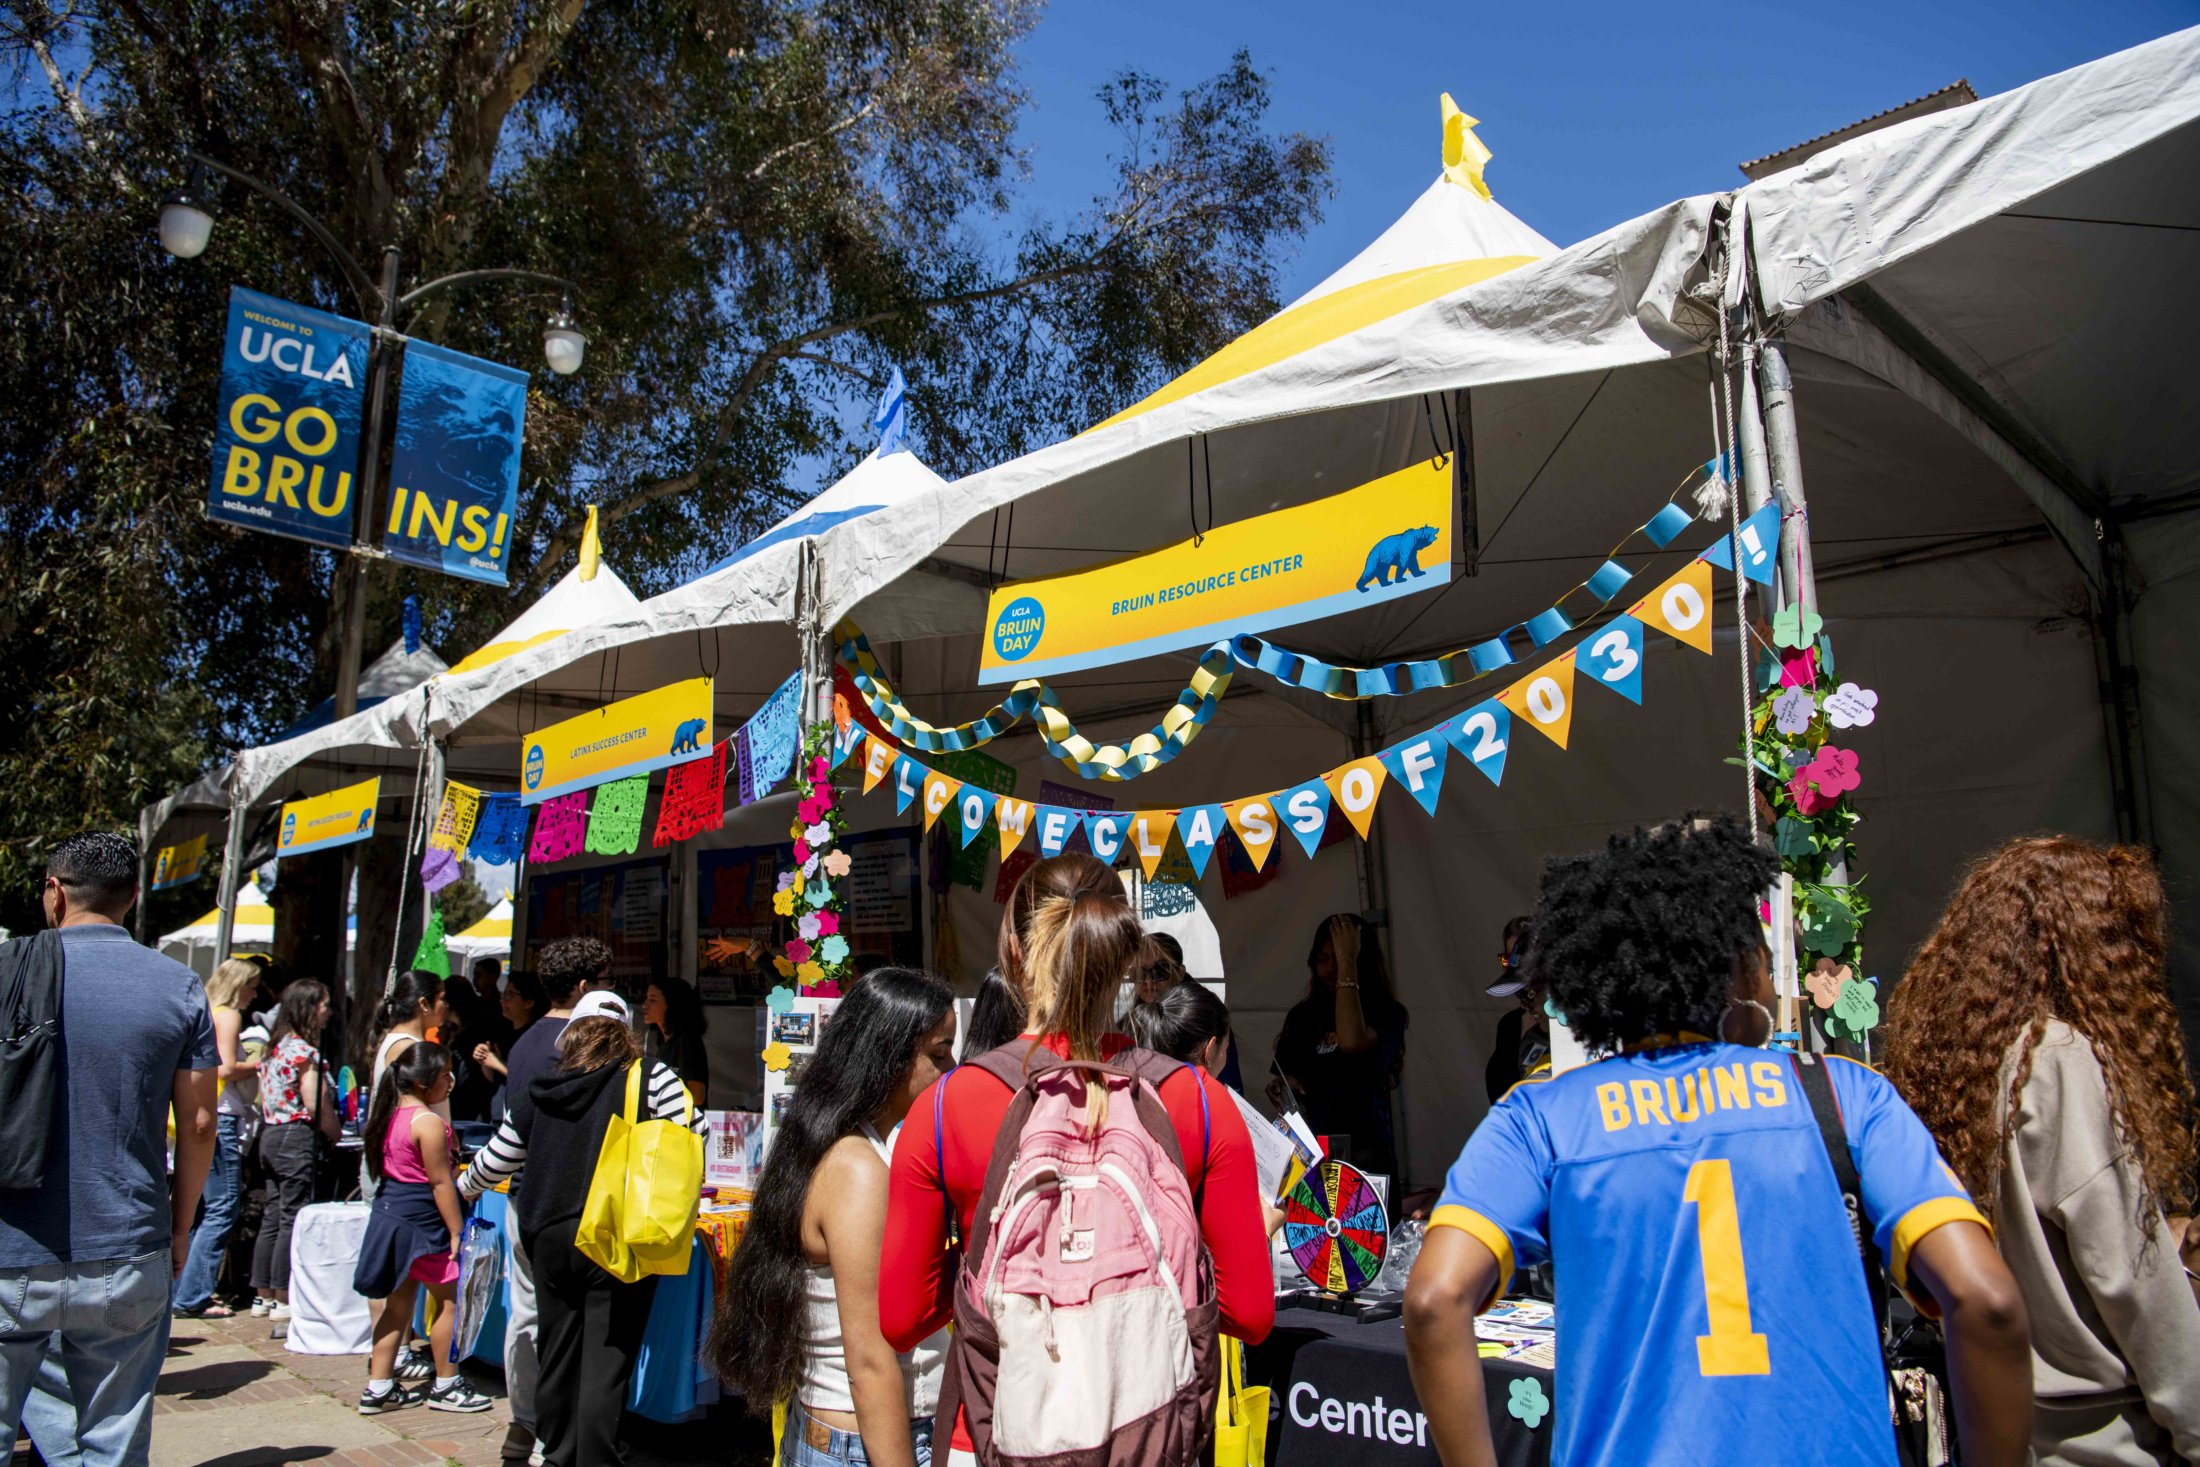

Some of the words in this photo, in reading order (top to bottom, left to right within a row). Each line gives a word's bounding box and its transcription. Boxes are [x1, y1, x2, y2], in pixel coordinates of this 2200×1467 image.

[243, 310, 296, 332] WELCOME
[299, 326, 313, 336] TO
[239, 326, 355, 389] UCLA
[229, 393, 338, 457] GO
[222, 445, 352, 518] BRU
[223, 500, 272, 518] ucla.edu
[387, 486, 510, 558] INS!
[469, 557, 499, 572] @ucla
[1111, 593, 1155, 616] BRUIN
[1158, 571, 1236, 604] RESOURCE
[1239, 554, 1303, 583] CENTER
[997, 617, 1041, 638] BRUIN
[1011, 606, 1031, 617] UCLA
[1002, 634, 1033, 653] DAY
[570, 744, 592, 759] LATINX
[592, 735, 619, 753] SUCCESS
[620, 727, 647, 743] CENTER
[526, 758, 543, 774] BRUIN
[528, 771, 539, 785] DAY
[1596, 1061, 1788, 1132] BRUINS
[1683, 1158, 1771, 1376] 1
[1288, 1381, 1429, 1447] Center
